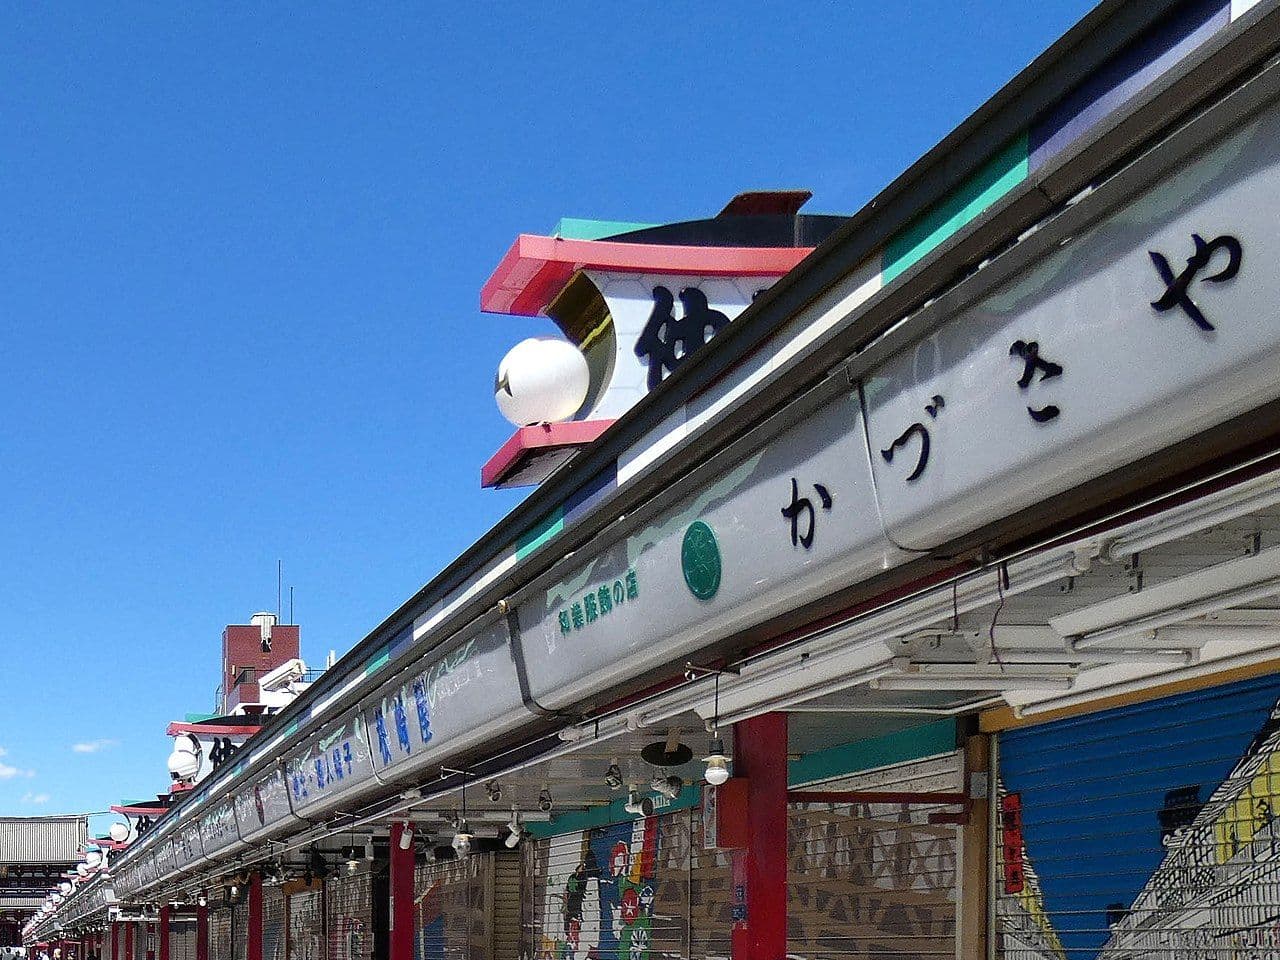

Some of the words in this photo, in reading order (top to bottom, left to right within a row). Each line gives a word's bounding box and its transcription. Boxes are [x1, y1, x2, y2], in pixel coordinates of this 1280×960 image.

[558, 569, 639, 636] 和装服飾の店
